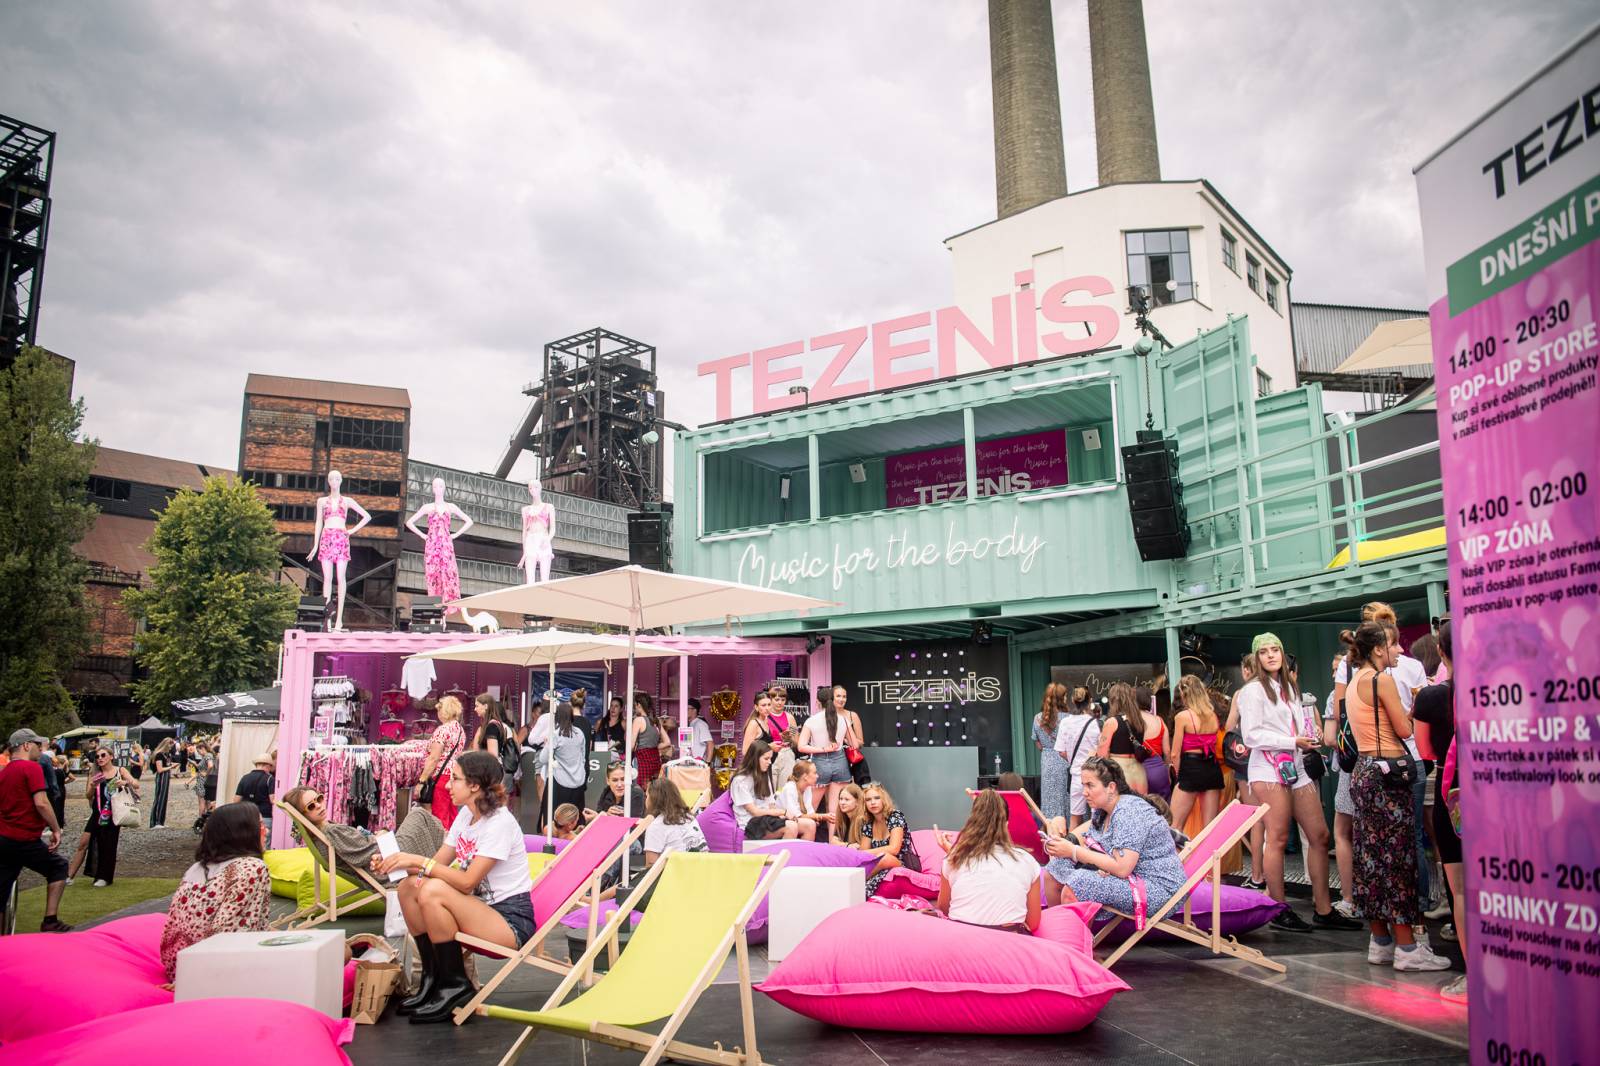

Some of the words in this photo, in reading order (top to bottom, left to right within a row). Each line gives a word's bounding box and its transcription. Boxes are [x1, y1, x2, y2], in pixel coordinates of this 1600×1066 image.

[1480, 195, 1577, 286] DNEŠNÍ
[1449, 336, 1497, 374] 14:00
[1516, 299, 1570, 344] 20:30
[1450, 359, 1522, 407] POP-UP
[1528, 322, 1599, 373] STORE
[1452, 409, 1468, 424] Kup
[1471, 404, 1479, 417] si
[1481, 396, 1499, 412] své
[1502, 378, 1546, 403] oblíbené
[1549, 355, 1599, 387] produkty
[1481, 401, 1537, 428] festivalové
[1459, 496, 1509, 528] 14:00
[1530, 472, 1587, 508] 02:00
[738, 543, 829, 589] Music
[832, 543, 880, 590] for
[887, 528, 942, 569] the
[944, 516, 1047, 573] body
[1459, 534, 1490, 561] VIP
[1494, 520, 1554, 554] ZÓNA
[1461, 564, 1485, 579] Naše
[1487, 559, 1505, 573] VIP
[1509, 554, 1535, 569] zóna
[1538, 551, 1547, 566] je
[1486, 573, 1525, 592] dosáhli
[1528, 567, 1568, 585] statusu
[1463, 596, 1513, 617] personálu
[1515, 597, 1522, 607] v
[1525, 588, 1564, 608] pop-up
[1470, 683, 1522, 708] 15:00
[1470, 717, 1567, 743] MAKE-UP
[1574, 715, 1591, 742] &
[1472, 749, 1484, 761] Ve
[1487, 747, 1525, 762] čtvrtek
[1528, 751, 1535, 761] a
[1538, 751, 1544, 761] v
[1547, 746, 1578, 765] pátek
[1583, 746, 1594, 761] si
[1495, 768, 1555, 787] festivalový
[1558, 768, 1584, 784] look
[1478, 856, 1534, 884] 15:00
[1479, 891, 1558, 927] DRINKY
[1516, 929, 1562, 948] voucher
[1565, 939, 1580, 953] na
[1490, 944, 1527, 962] našem
[1530, 953, 1572, 974] pop-up
